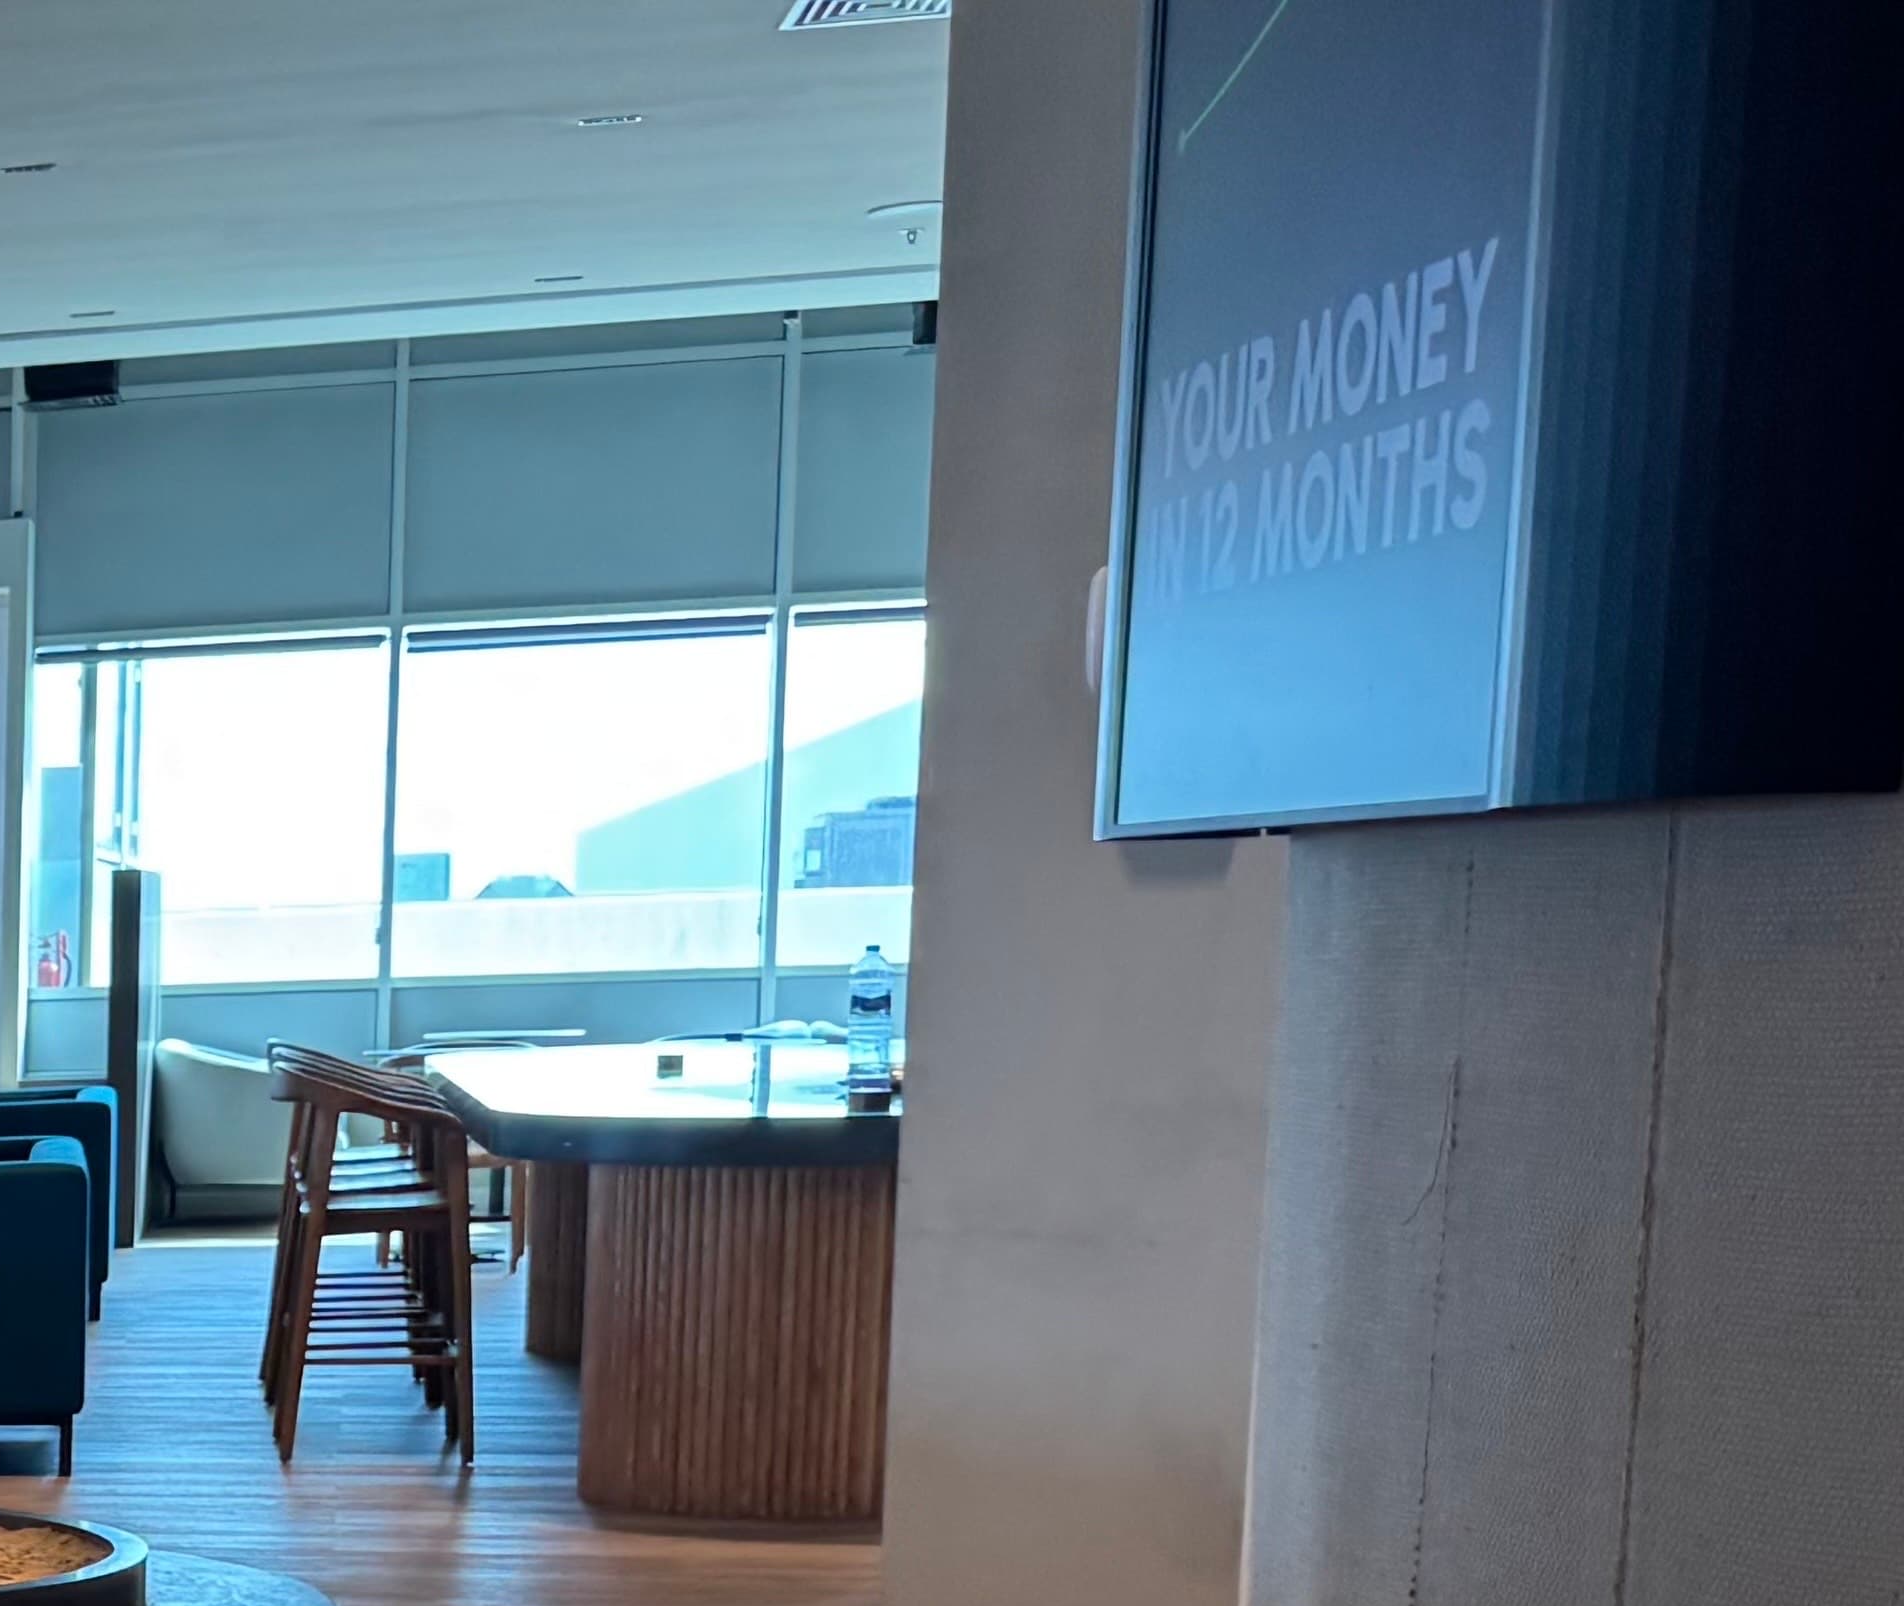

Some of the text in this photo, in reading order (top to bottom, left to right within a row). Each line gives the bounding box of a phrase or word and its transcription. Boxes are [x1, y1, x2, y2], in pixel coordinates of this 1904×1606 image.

[1157, 237, 1499, 478] YOUR MONEY
[1149, 397, 1492, 605] IN 12 MONTHS
